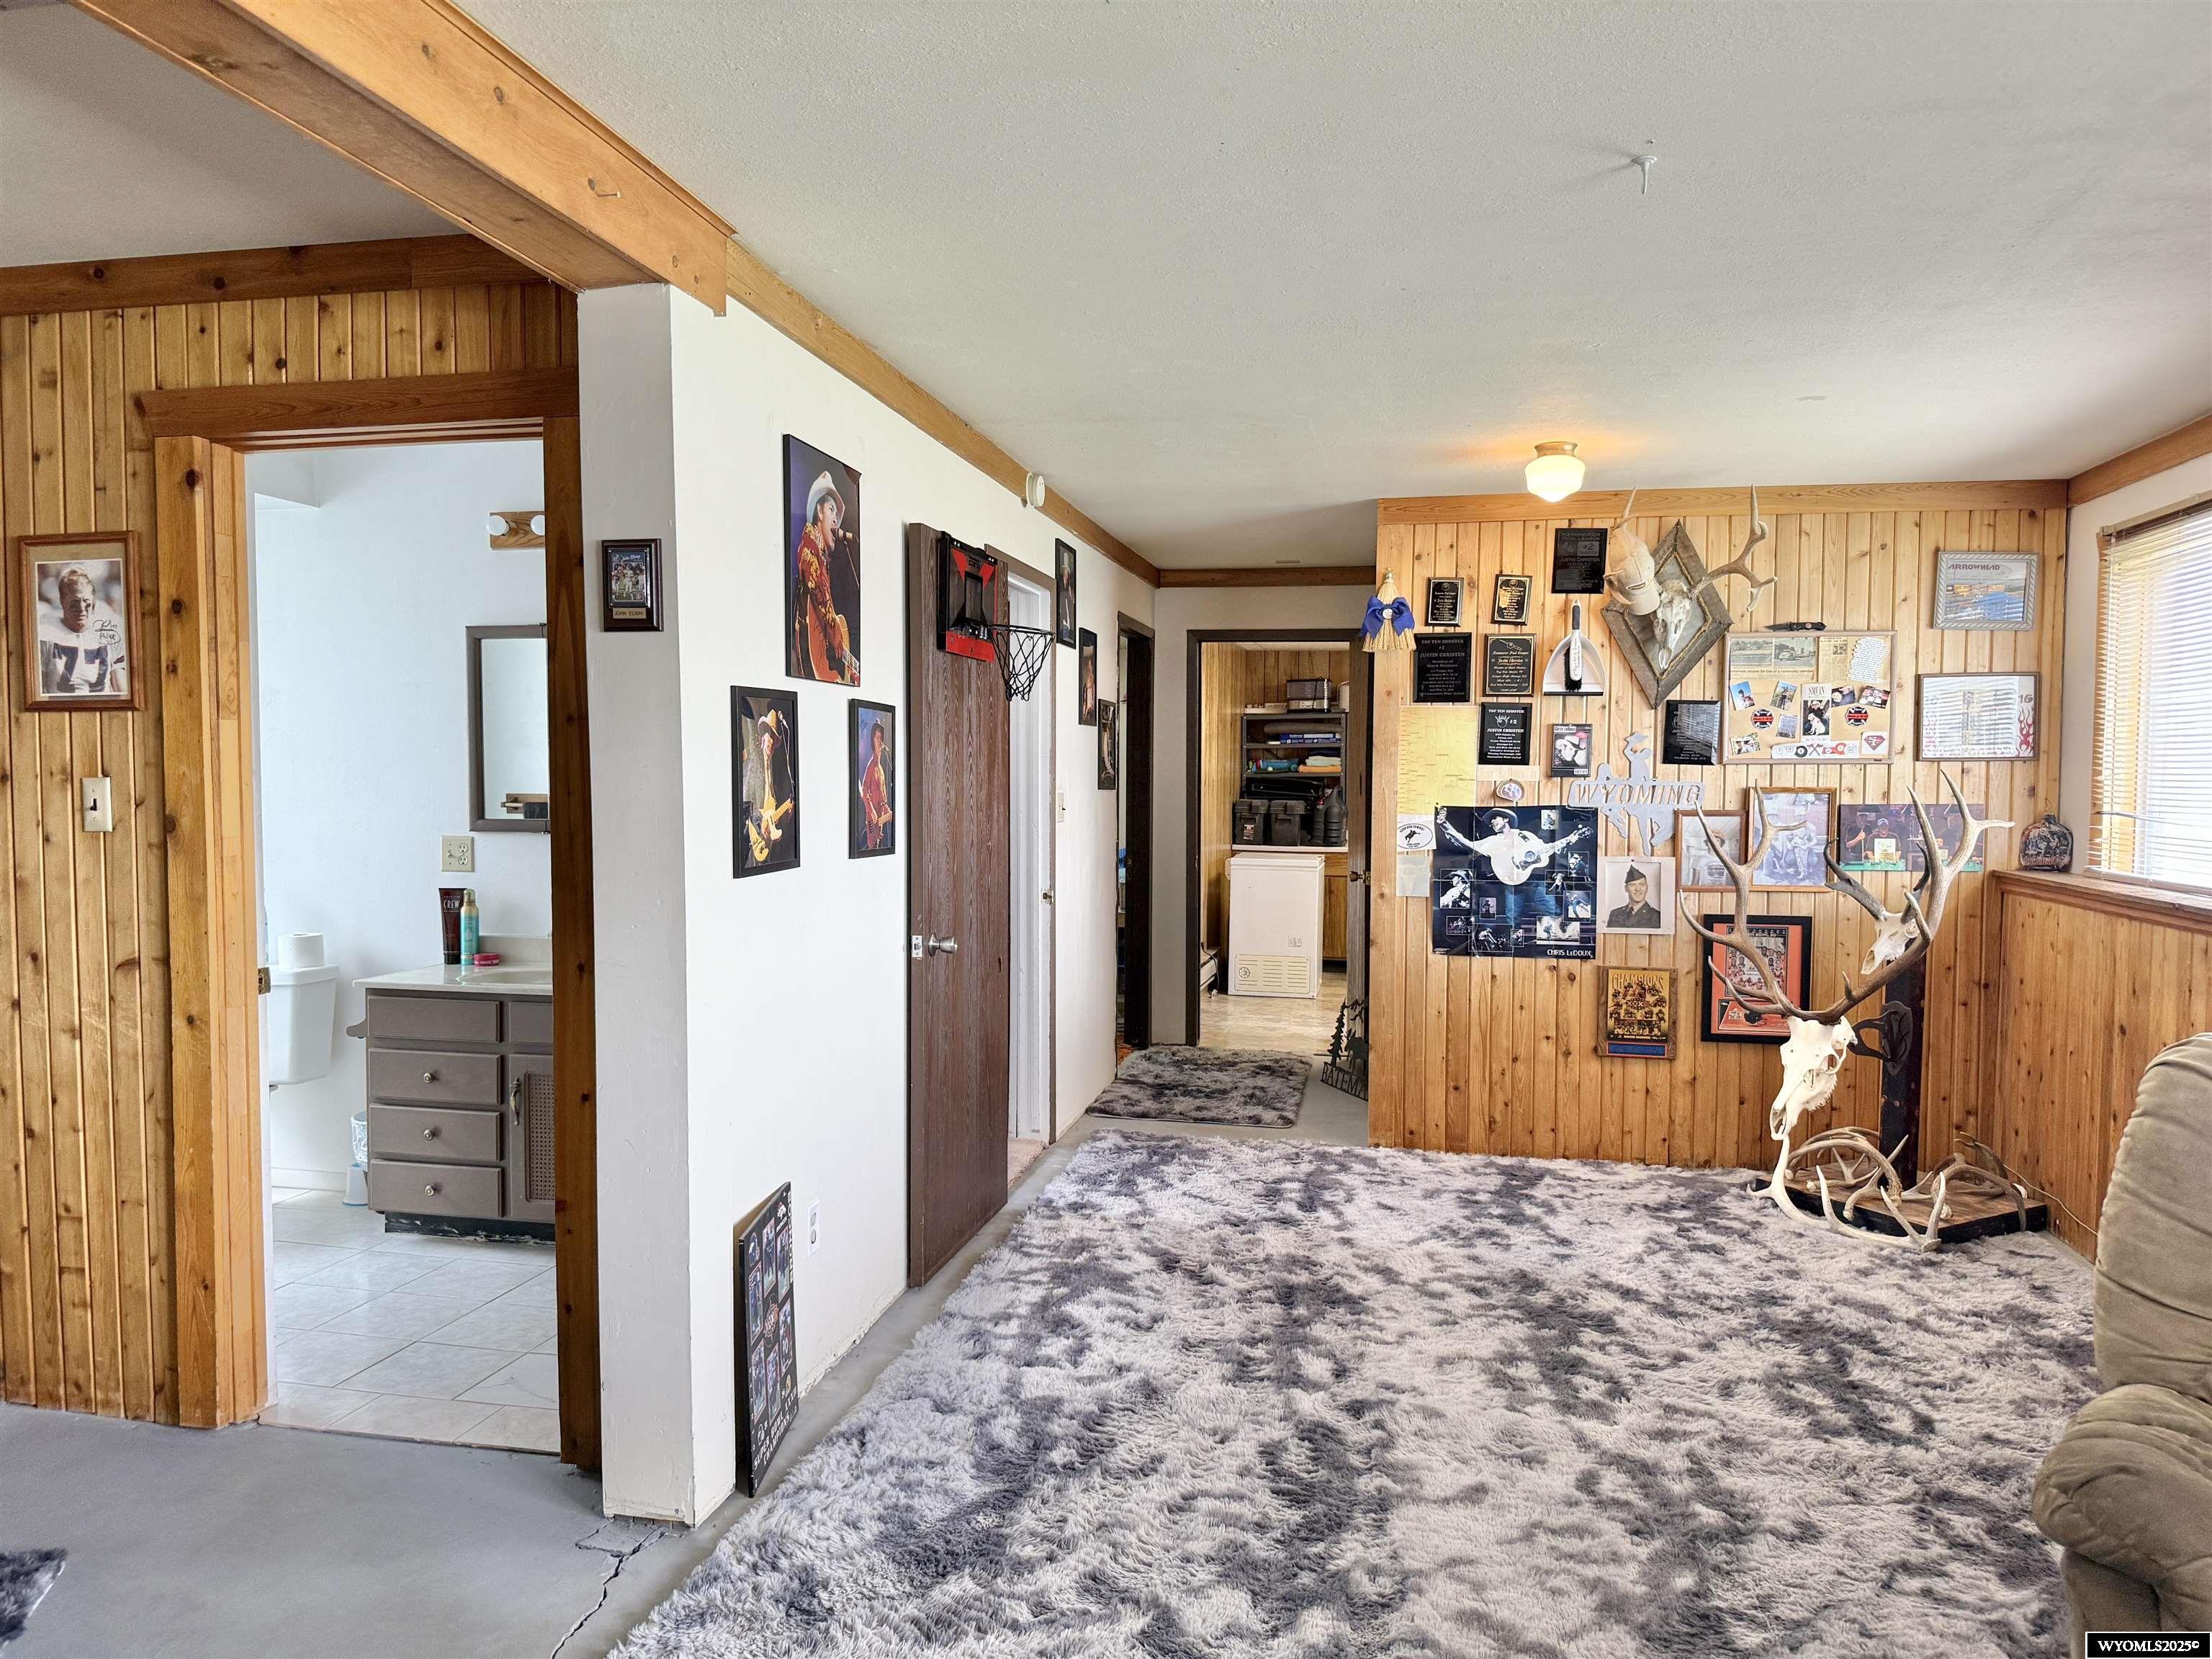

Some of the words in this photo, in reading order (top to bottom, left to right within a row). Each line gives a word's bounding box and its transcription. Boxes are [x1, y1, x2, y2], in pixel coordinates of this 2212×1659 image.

[2018, 694, 2033, 703] 16
[1576, 783, 1701, 806] WYOMING
[444, 899, 460, 909] CREW
[1612, 973, 1664, 991] CHAMPIONS
[754, 1435, 770, 1470] SUPER
[770, 1410, 784, 1439] BOWL
[763, 1411, 790, 1466] CHAMPIONS
